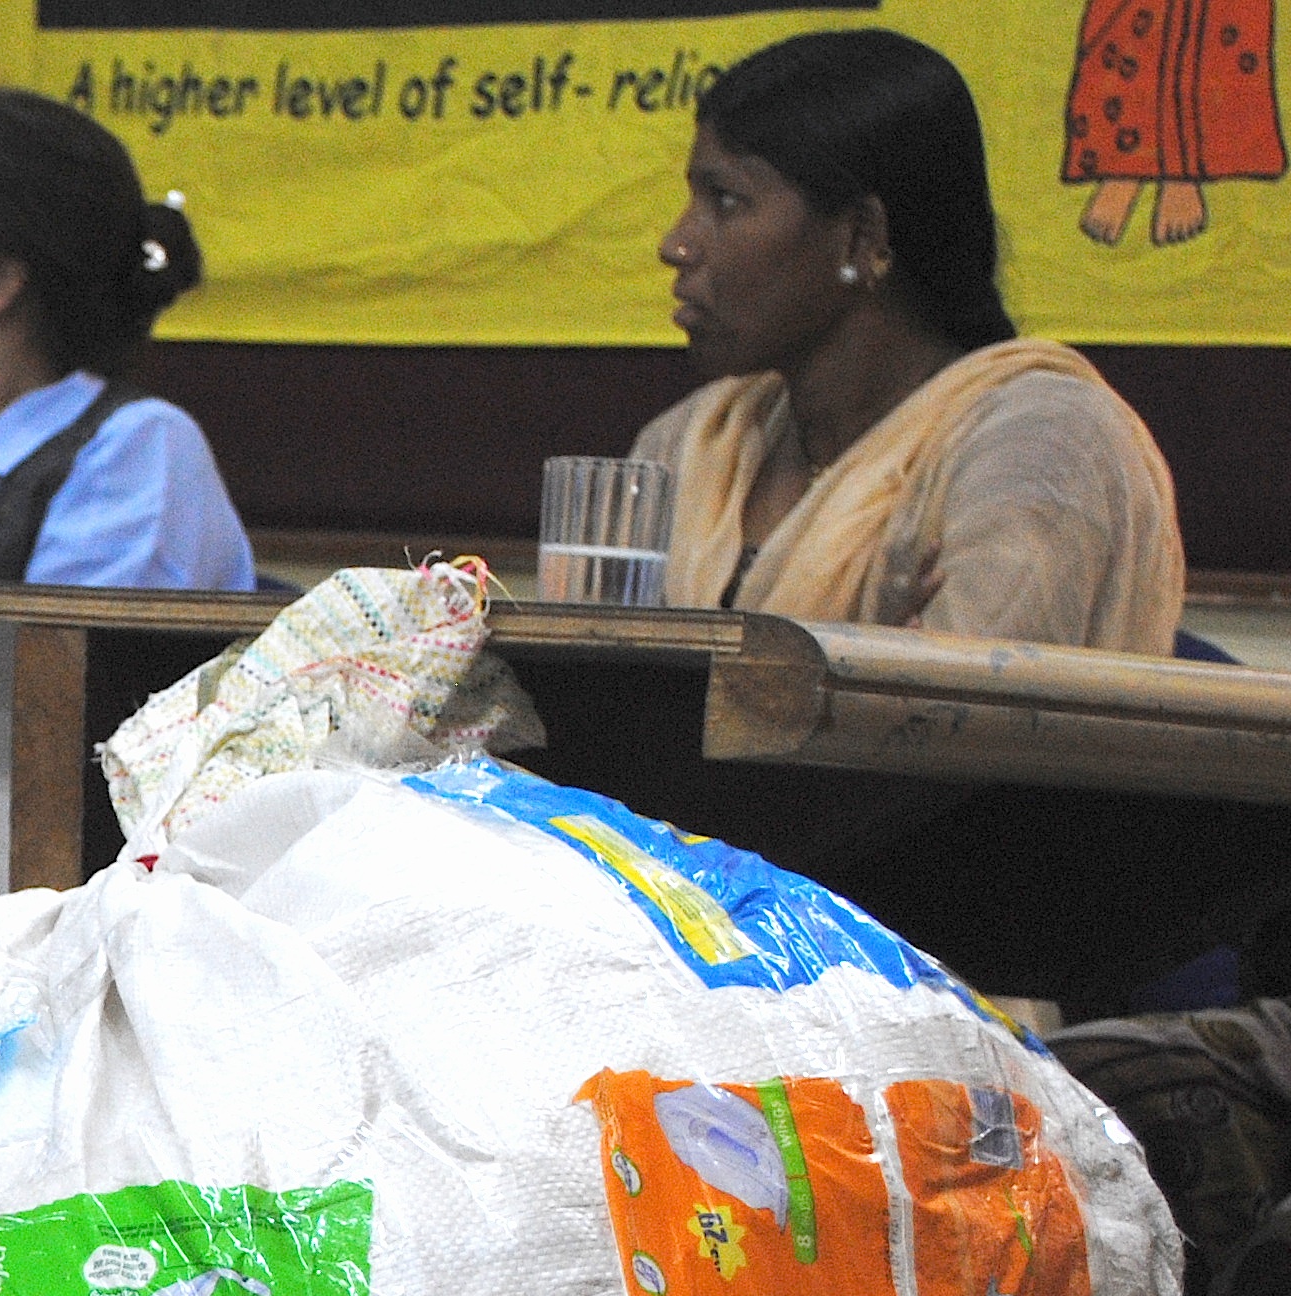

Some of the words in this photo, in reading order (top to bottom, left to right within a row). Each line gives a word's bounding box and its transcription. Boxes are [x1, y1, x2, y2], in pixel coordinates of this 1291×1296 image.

[69, 59, 95, 110] A
[111, 58, 261, 136] higher
[273, 59, 387, 121] level
[399, 56, 458, 120] of
